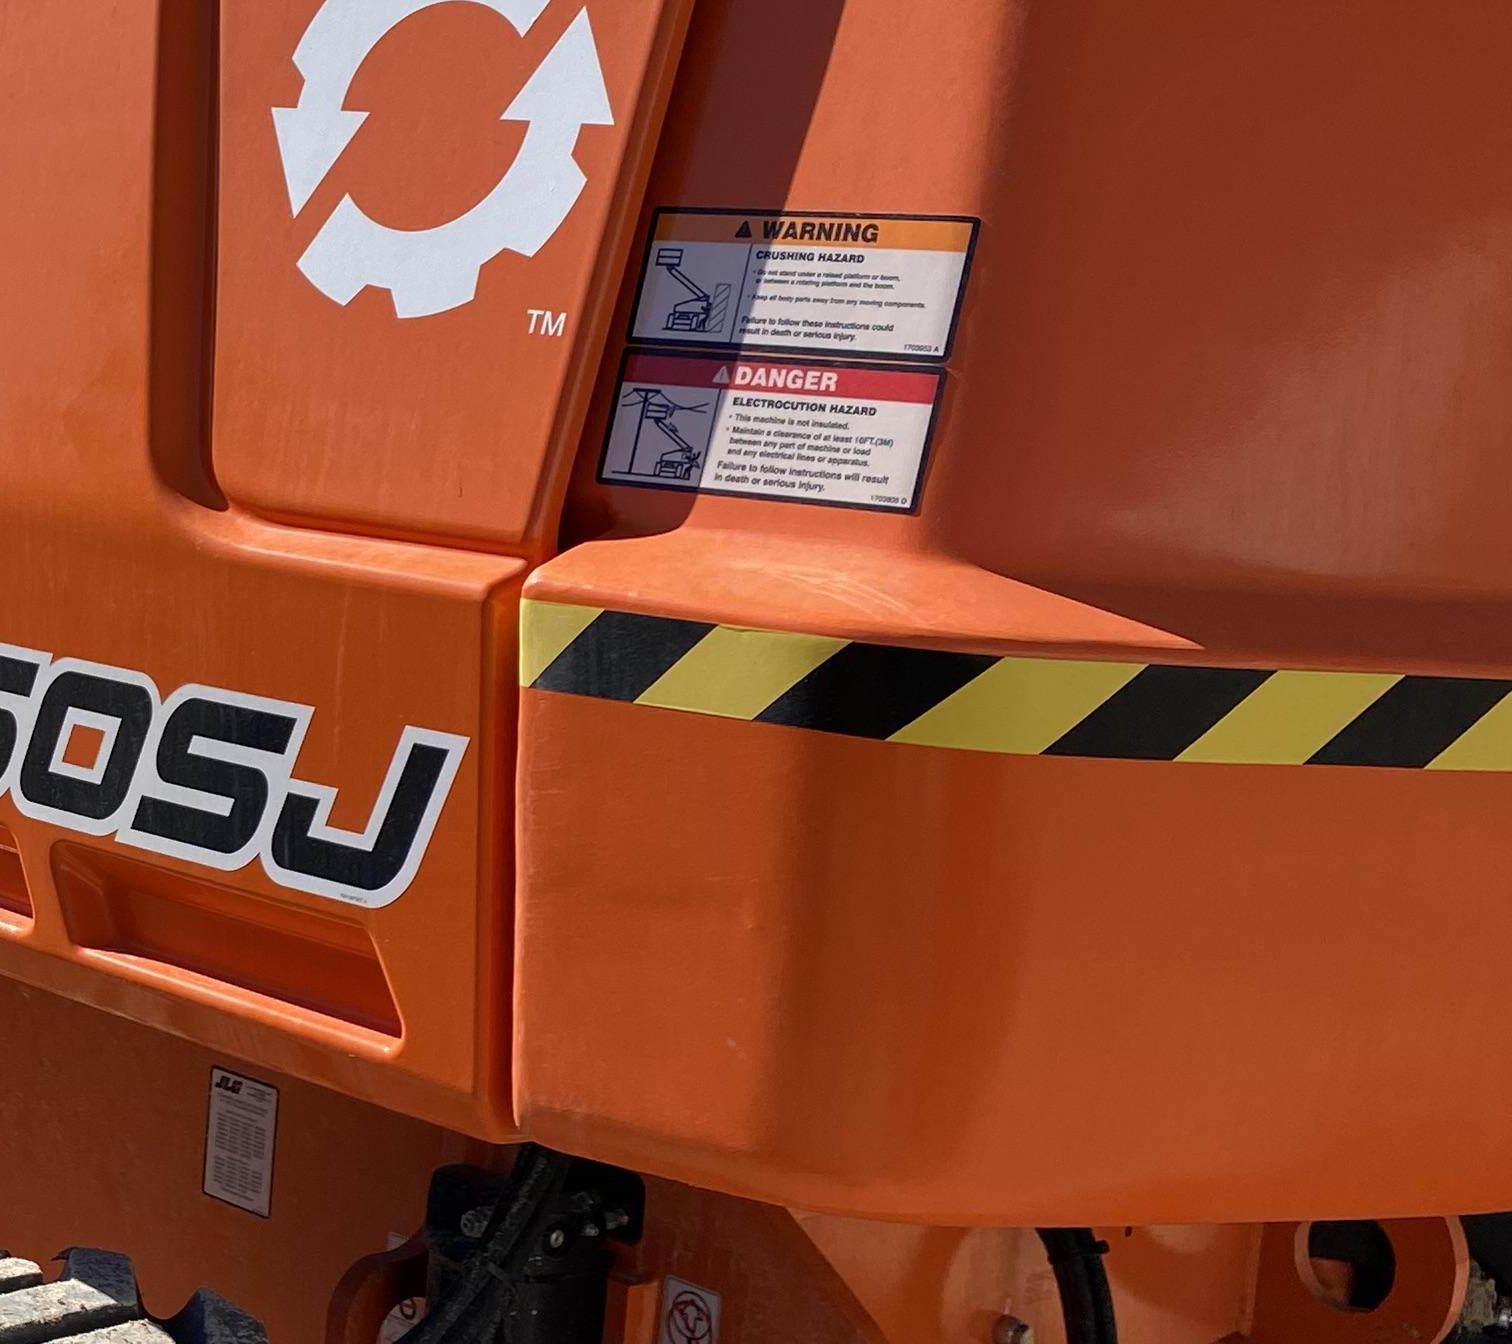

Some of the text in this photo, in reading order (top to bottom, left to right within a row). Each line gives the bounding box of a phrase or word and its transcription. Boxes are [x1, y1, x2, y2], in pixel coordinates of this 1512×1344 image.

[762, 220, 880, 243] WARNING
[756, 250, 865, 264] CRUSHING HAZARD
[526, 308, 567, 337] TM
[741, 316, 767, 324] Failure
[777, 318, 800, 326] follow
[802, 319, 823, 327] these
[824, 320, 870, 330] instructions
[872, 323, 894, 332] could
[739, 326, 761, 334] result
[761, 327, 769, 335] in
[770, 328, 792, 336] death
[803, 331, 831, 339] serious
[734, 366, 838, 392] DANGER
[732, 396, 877, 416] ELECTROCUTION HAZARD
[735, 413, 751, 422] This
[753, 415, 786, 425] machine
[796, 419, 810, 427] not
[731, 426, 765, 435] Maintain
[773, 429, 812, 440] clearance
[833, 434, 852, 444] least
[727, 448, 741, 456] and
[743, 450, 757, 458] any
[759, 450, 795, 460] electrical
[796, 453, 815, 462] lines
[729, 437, 761, 446] between
[763, 440, 777, 449] any
[779, 441, 795, 450] part
[807, 444, 840, 453] machine
[853, 447, 871, 456] load
[714, 473, 723, 481] in
[724, 474, 749, 484] death
[750, 478, 761, 486] or
[763, 478, 796, 488] serious
[717, 460, 889, 484] Failure to follow instructions will result
